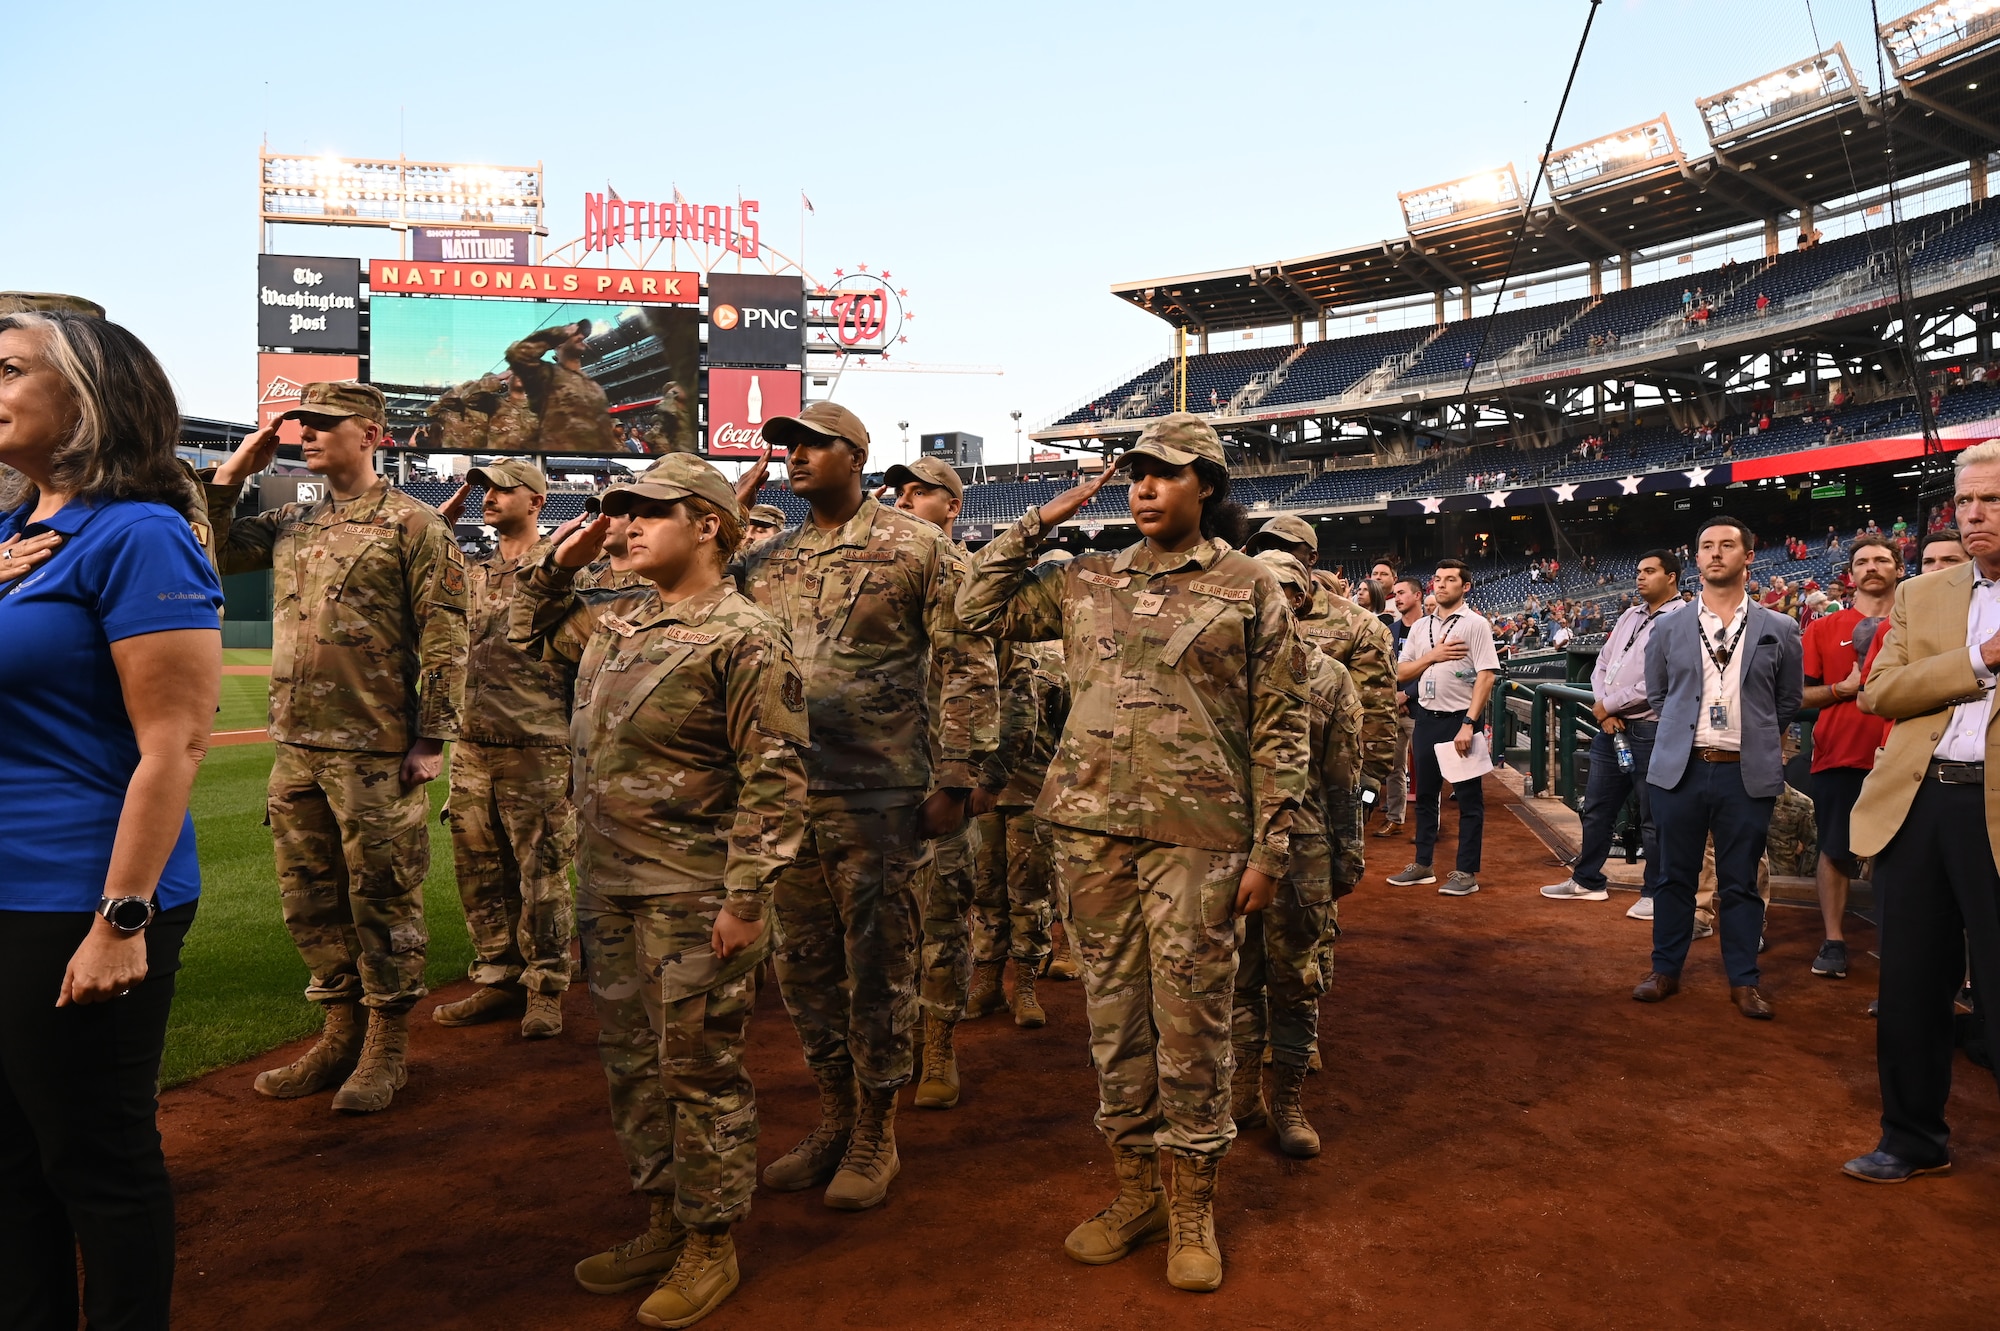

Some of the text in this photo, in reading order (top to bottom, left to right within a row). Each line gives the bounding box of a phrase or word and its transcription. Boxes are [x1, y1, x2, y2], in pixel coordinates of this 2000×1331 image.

[426, 229, 480, 238] SHOW SOME
[584, 192, 759, 258] NATIONALS
[441, 238, 515, 260] NATITUDE
[292, 267, 323, 288] The
[381, 266, 682, 296] NATIONALS PARK
[261, 286, 355, 313] Washington
[288, 313, 327, 335] Post
[741, 307, 798, 330] PNC
[1519, 367, 1582, 384] FRANK HOWARD
[346, 524, 395, 538] U.S. AIR FORCE
[167, 591, 206, 601] Columbia
[1192, 583, 1249, 599] U.S. AIR FORCE
[667, 627, 682, 640] U.S.
